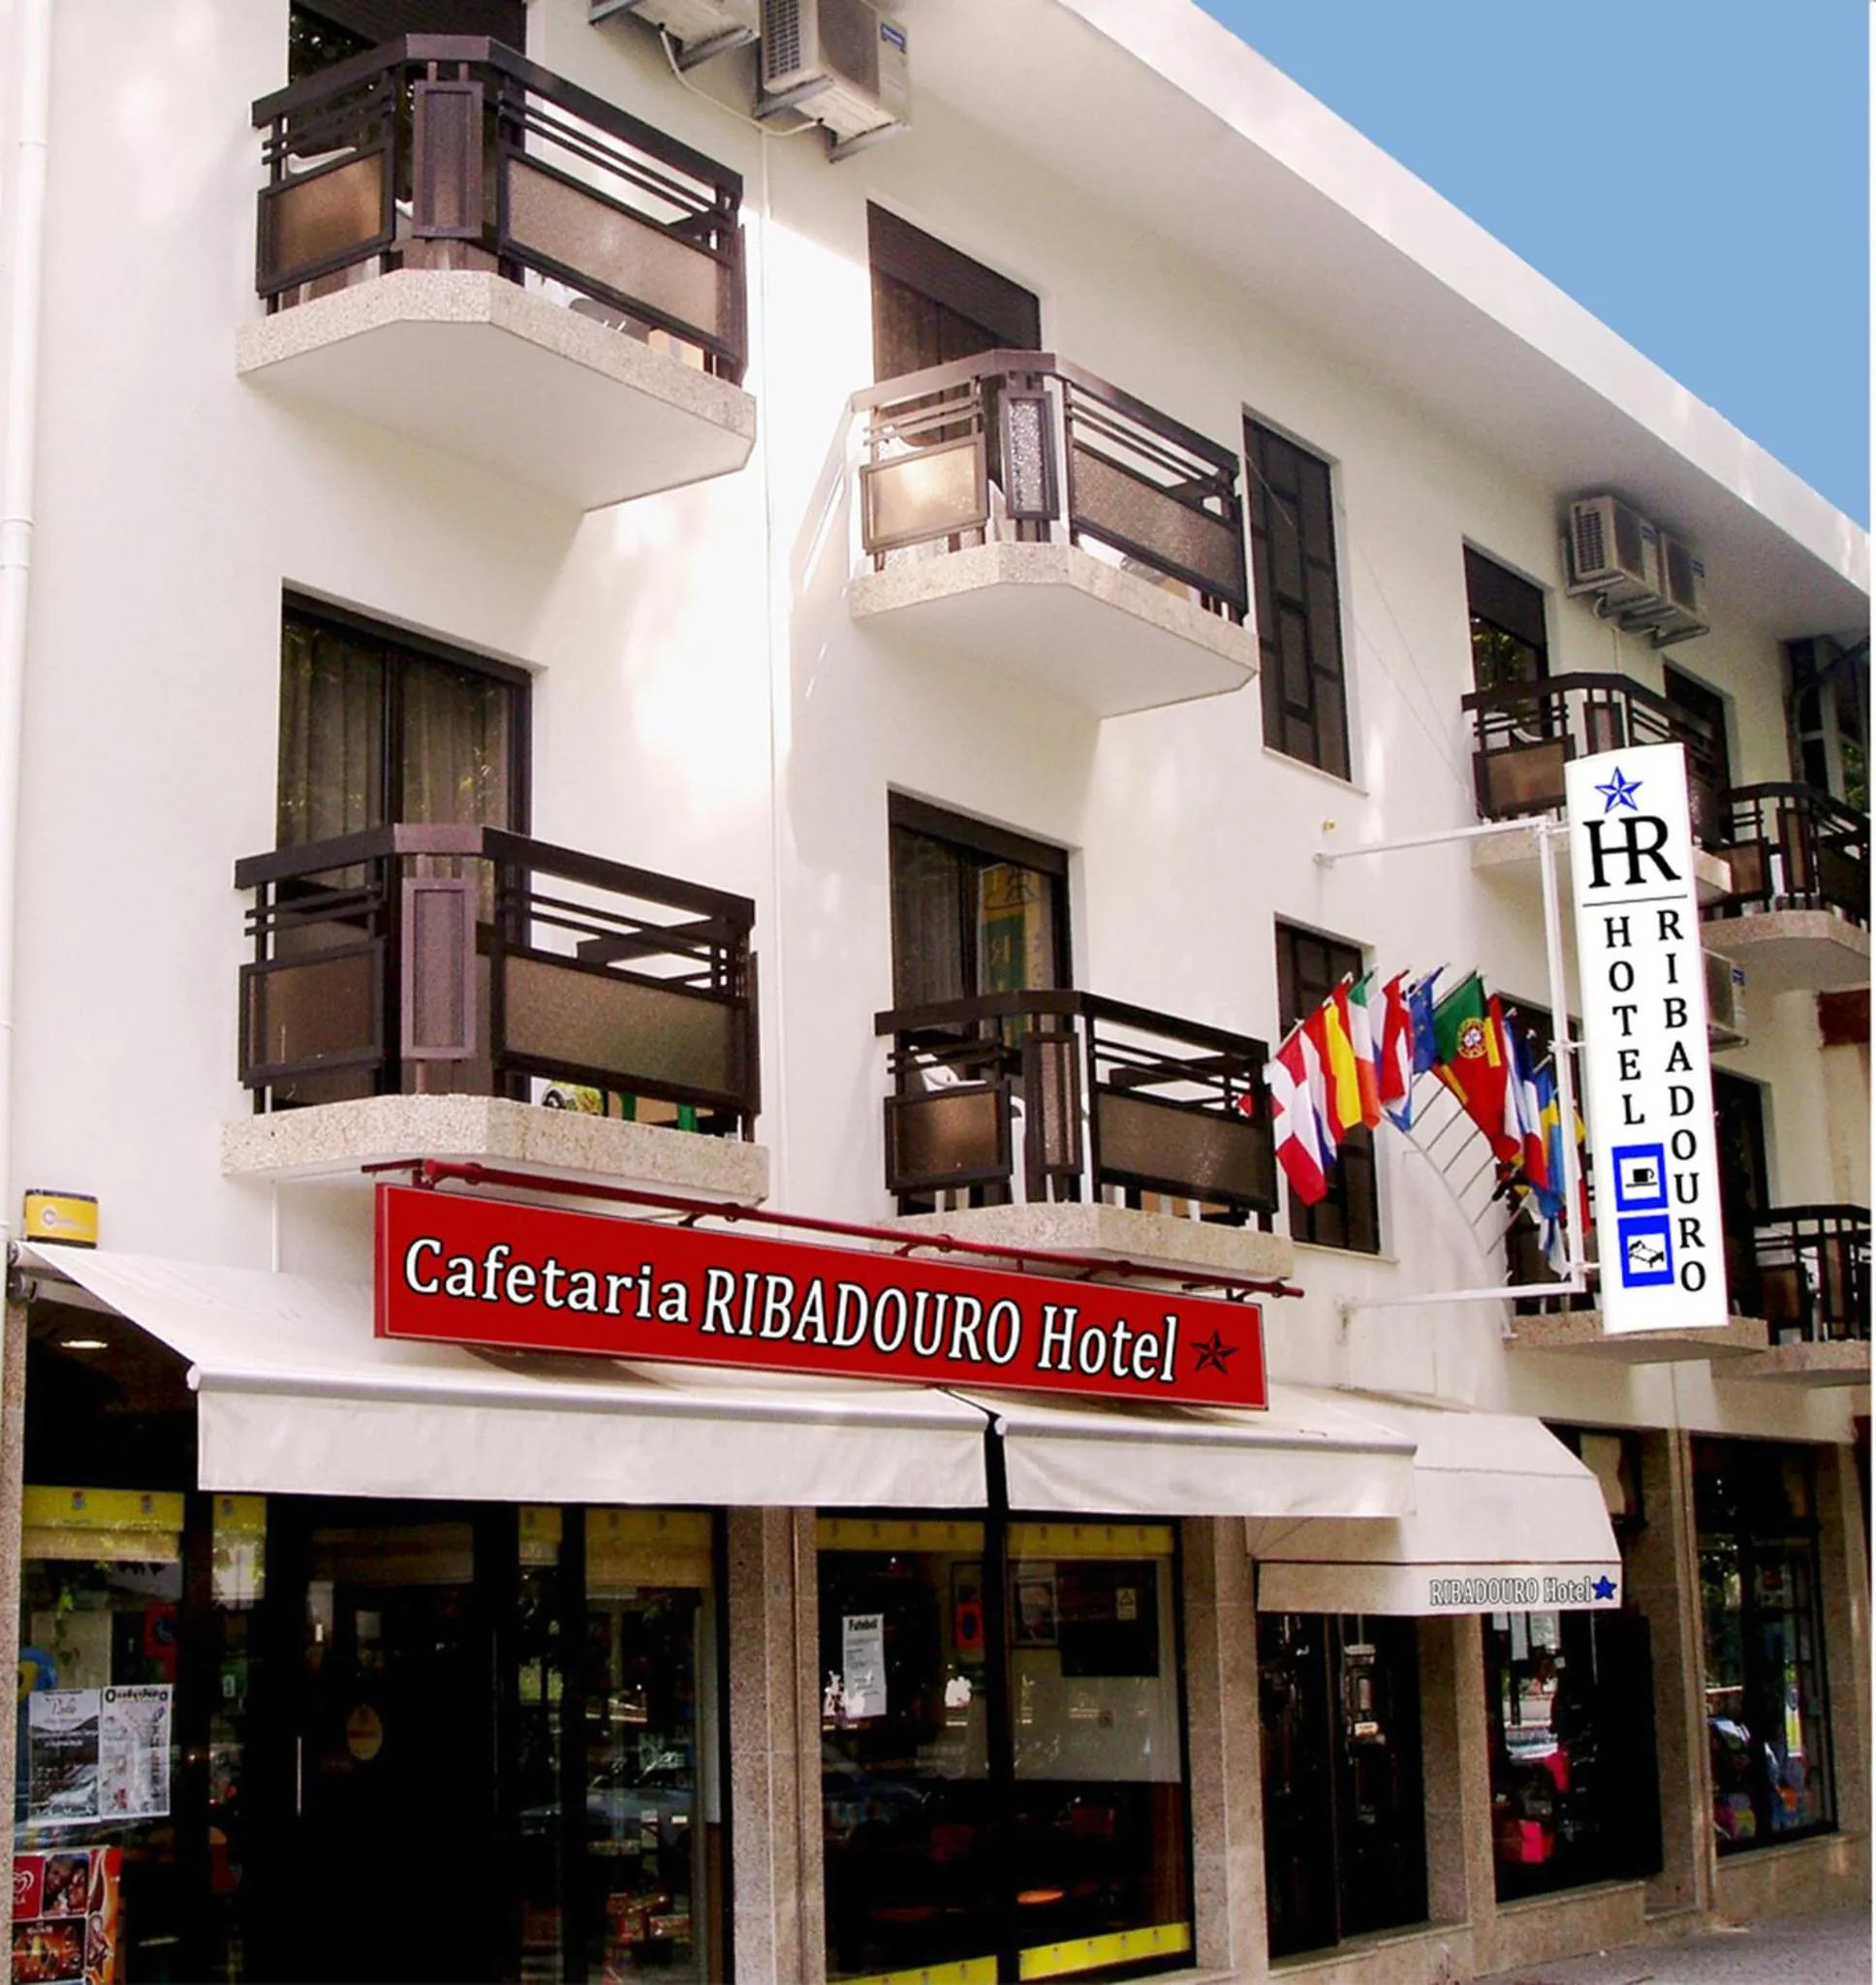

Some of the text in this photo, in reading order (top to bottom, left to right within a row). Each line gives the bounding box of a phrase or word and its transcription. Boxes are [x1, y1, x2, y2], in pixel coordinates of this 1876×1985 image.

[1582, 815, 1681, 889] HR
[1604, 916, 1645, 1125] HOTEL
[1656, 909, 1706, 1293] RIBADOURO
[404, 1238, 1178, 1383] Cafetaria RIBADOURO Hotel
[1429, 1577, 1592, 1605] RIBADOURO Hotel
